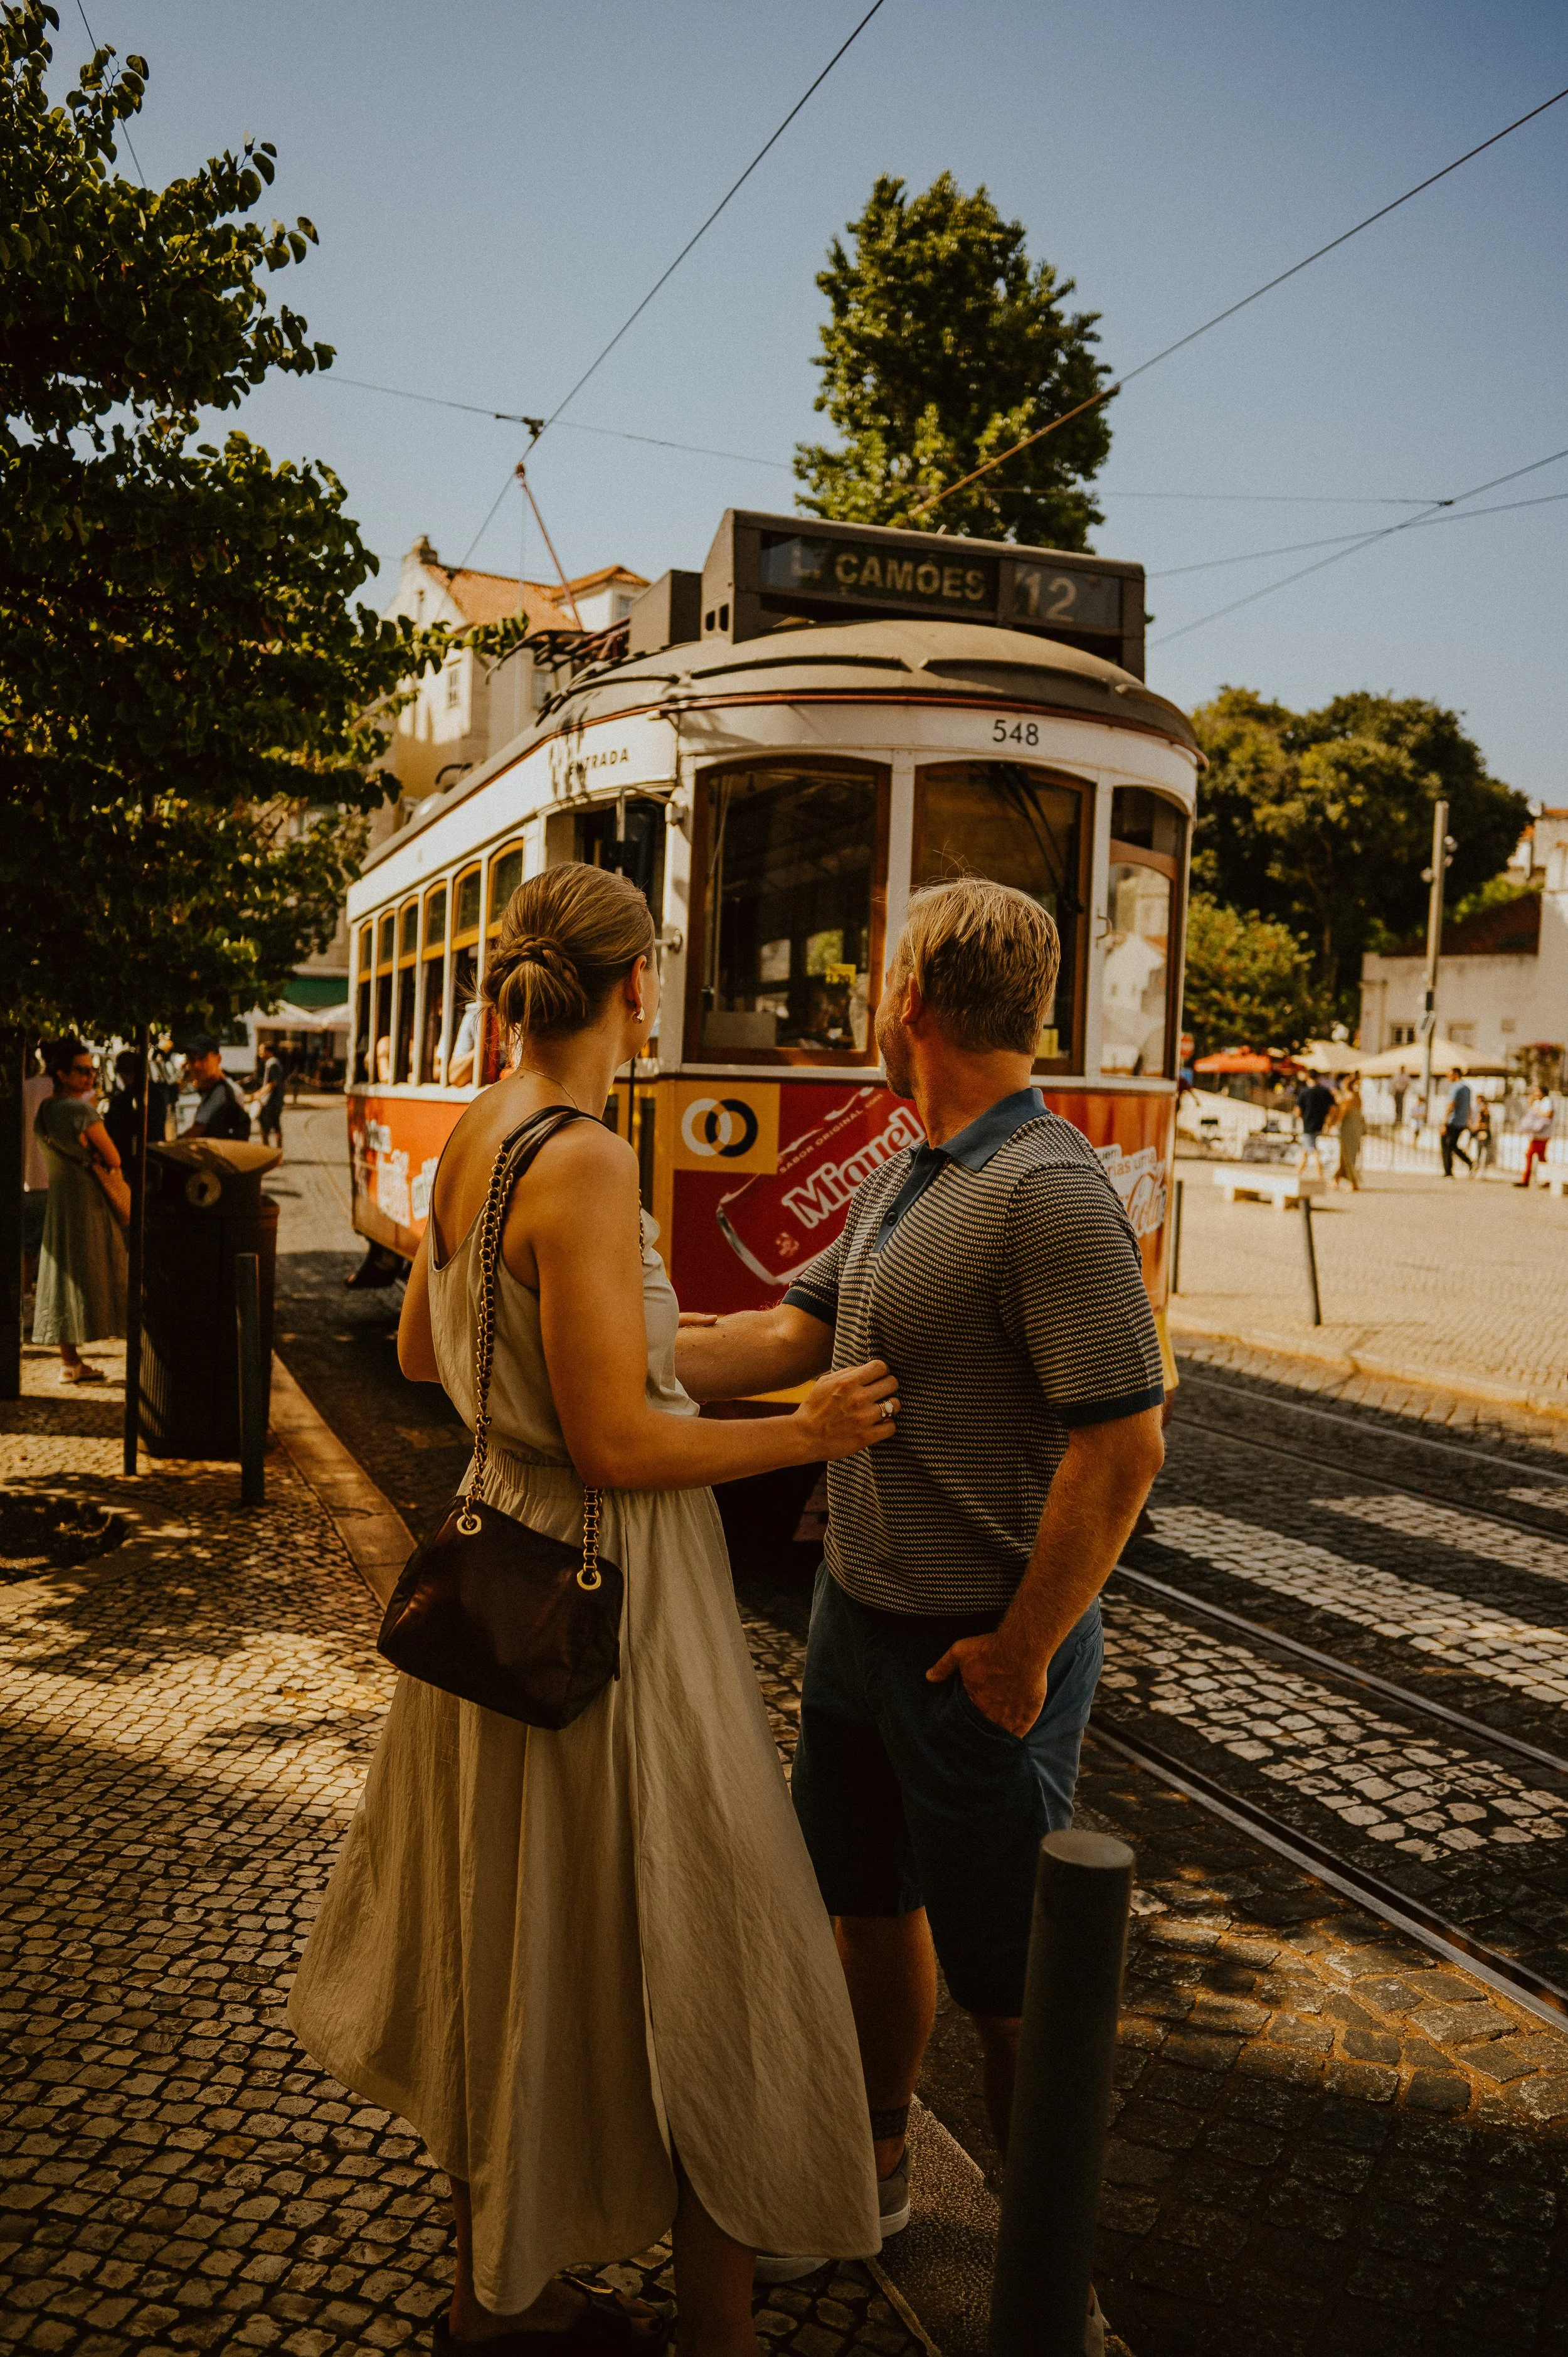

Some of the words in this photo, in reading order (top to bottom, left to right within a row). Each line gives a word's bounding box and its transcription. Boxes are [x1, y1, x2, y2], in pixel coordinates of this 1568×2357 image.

[1024, 572, 1078, 622] 12
[992, 719, 1039, 746] 548
[779, 1146, 815, 1174] SABOR
[815, 1109, 864, 1146] ORIGINAL
